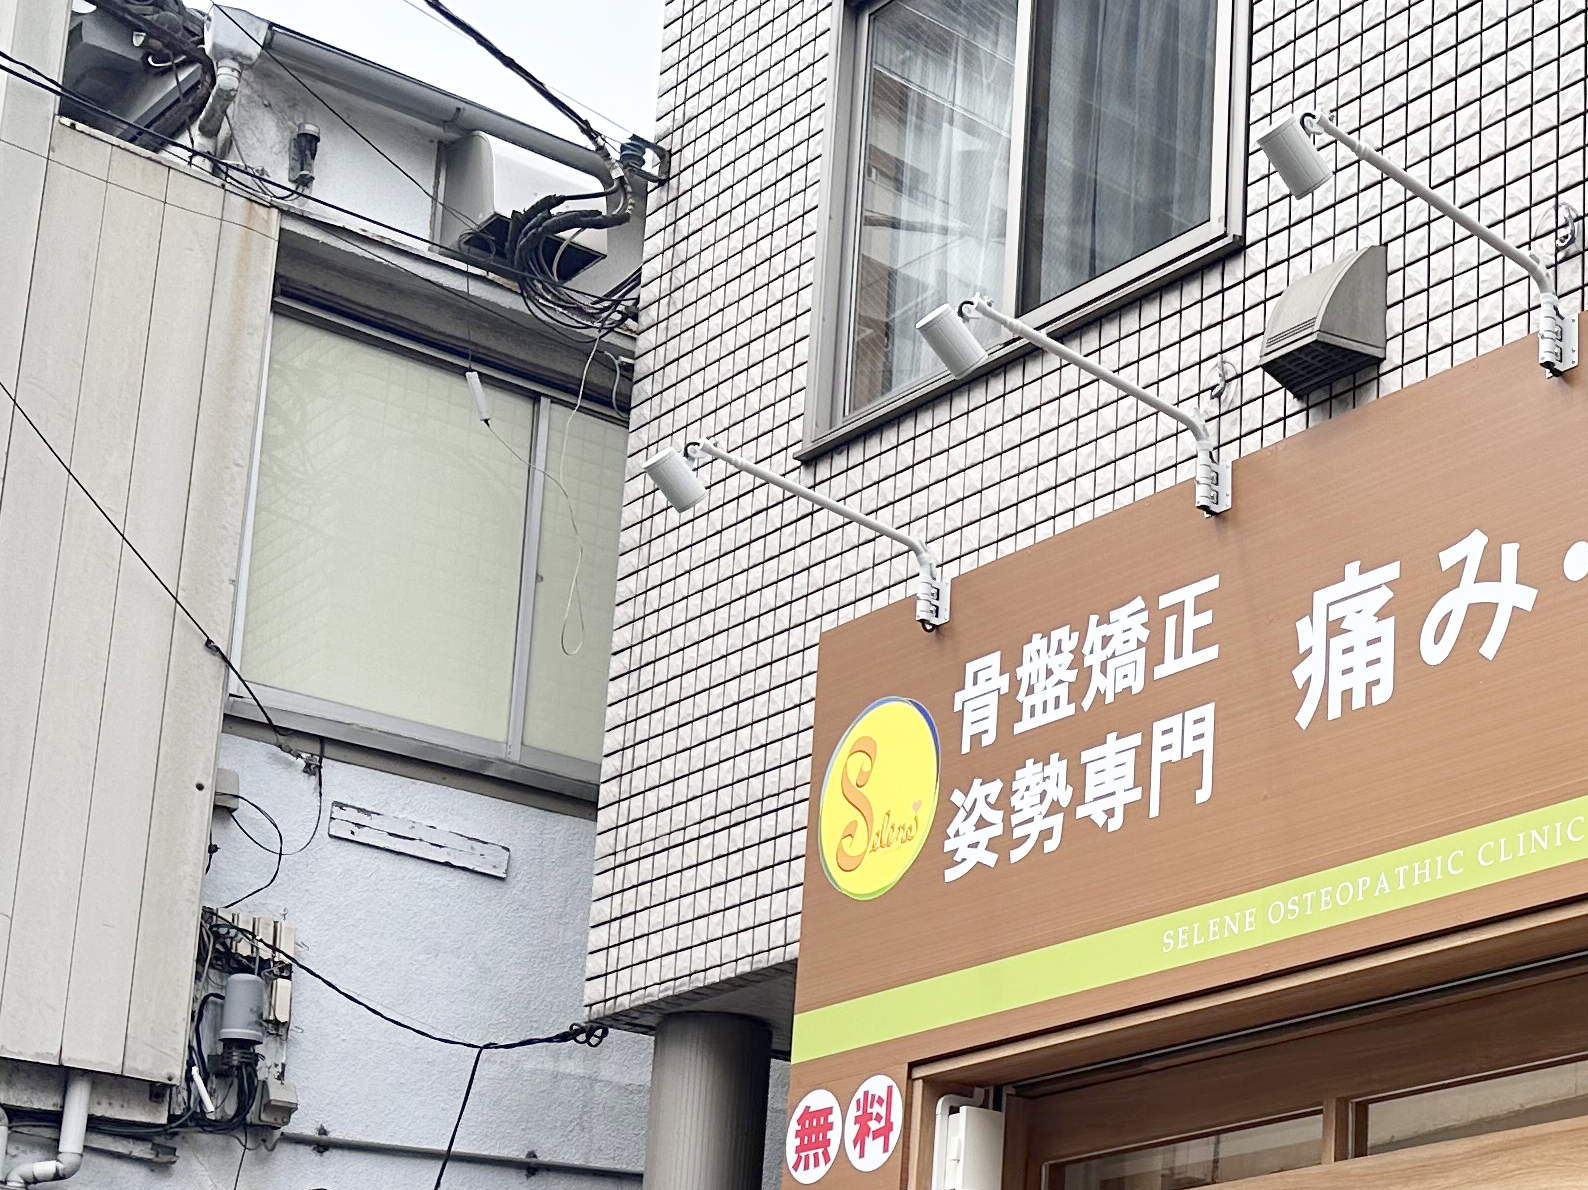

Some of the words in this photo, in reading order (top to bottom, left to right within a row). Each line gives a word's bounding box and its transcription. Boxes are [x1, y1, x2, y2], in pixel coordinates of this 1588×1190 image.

[953, 574, 1221, 755] 骨盤矯正
[942, 701, 1216, 884] 姿勢専門
[1161, 907, 1258, 953] SELENE
[1267, 849, 1466, 926] OSTEOPATHIC
[1476, 816, 1587, 868] CLINIC
[791, 1087, 899, 1177] 無料
